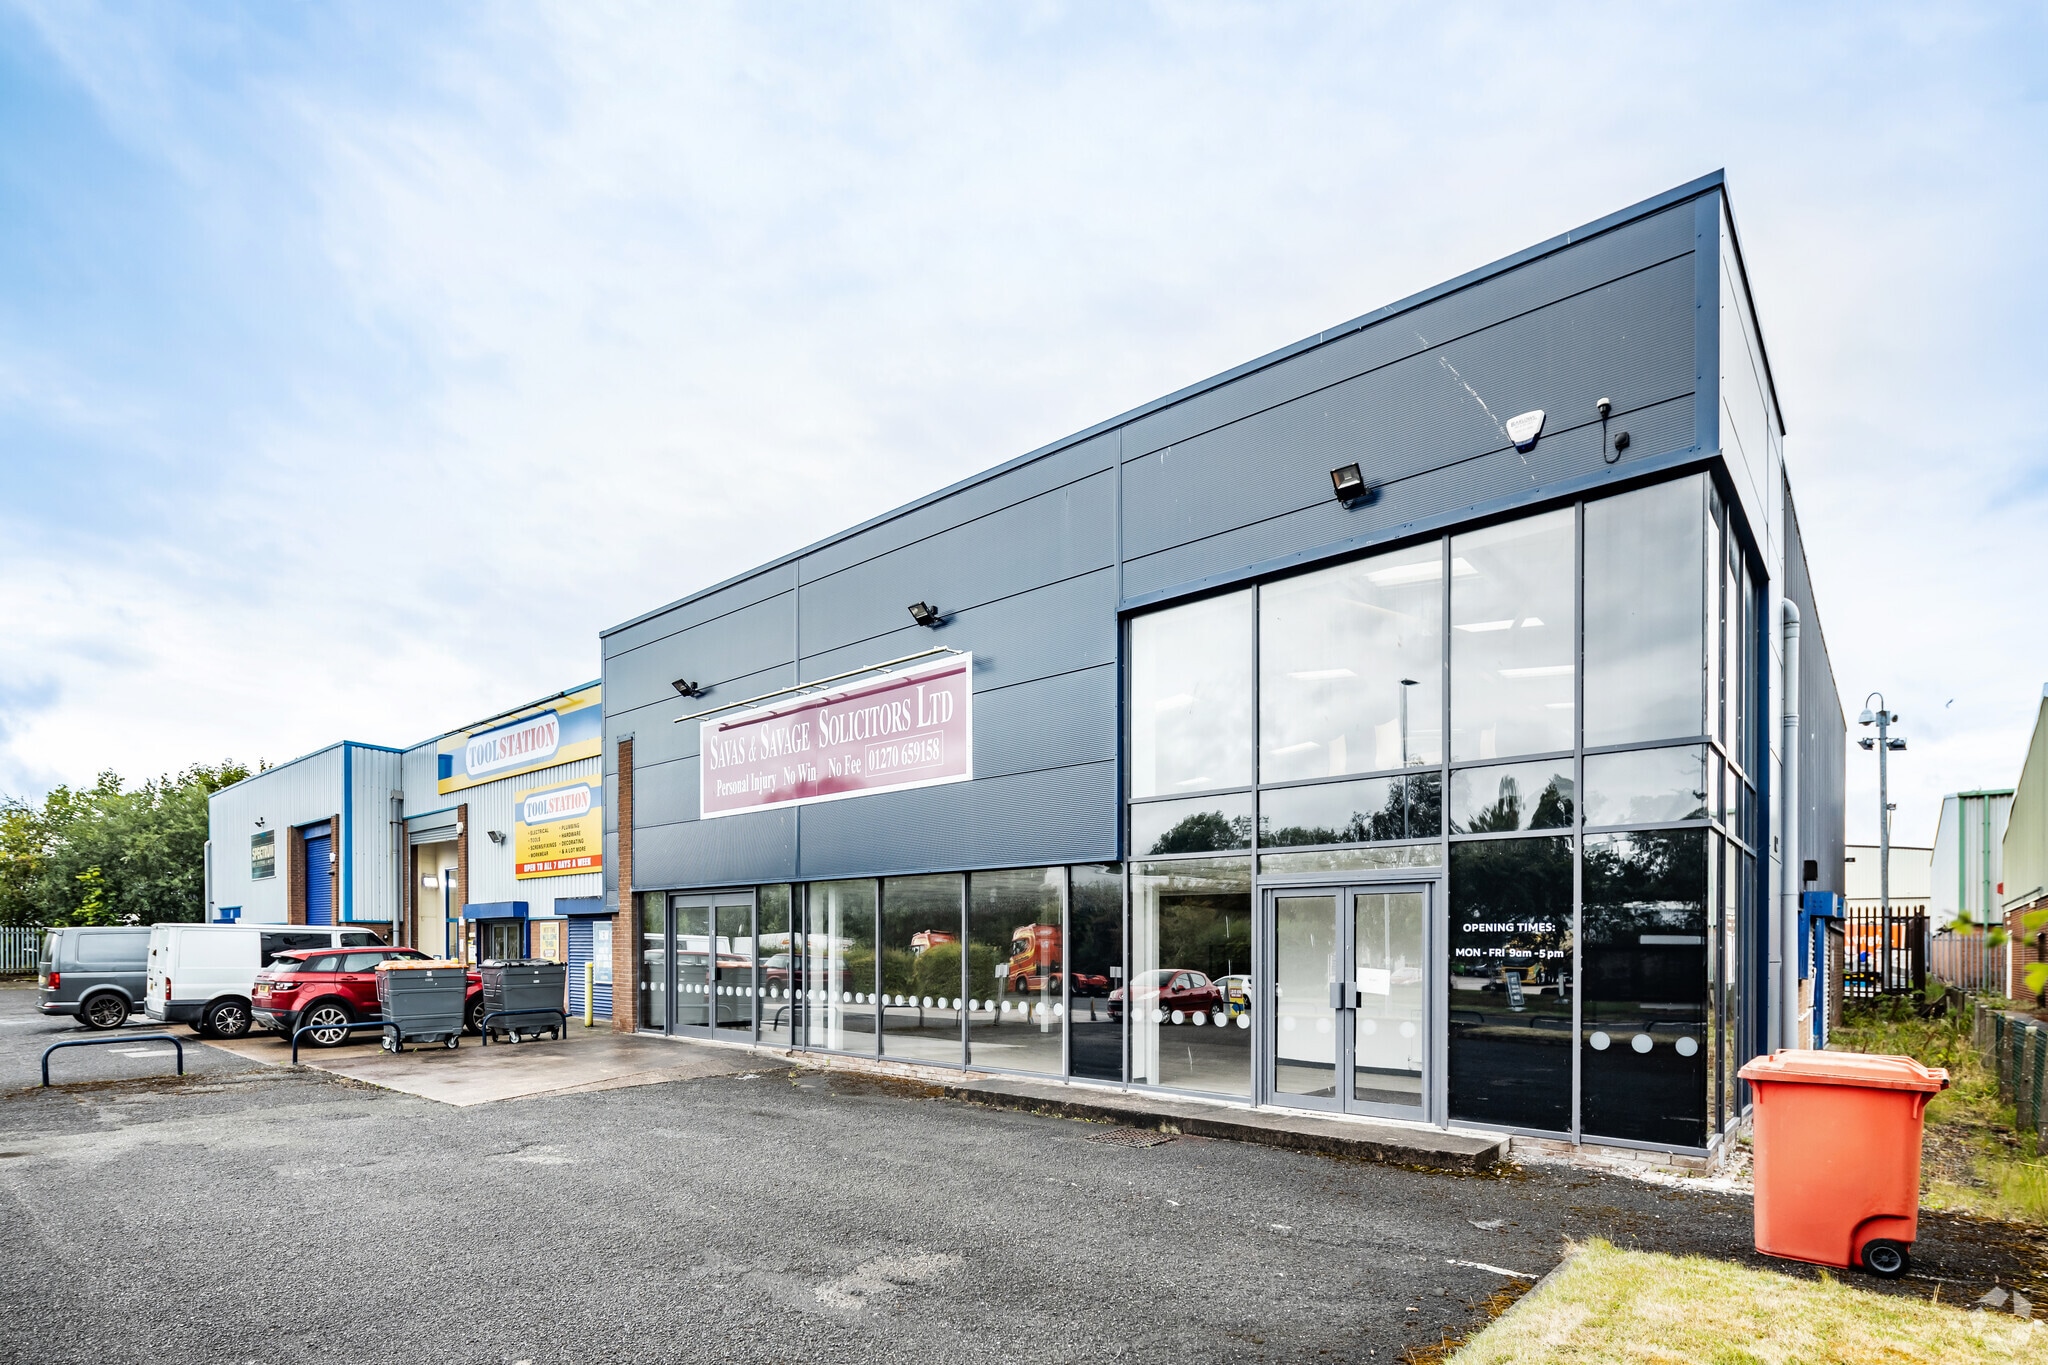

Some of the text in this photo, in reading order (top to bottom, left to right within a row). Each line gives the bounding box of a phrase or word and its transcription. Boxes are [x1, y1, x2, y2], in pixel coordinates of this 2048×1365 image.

[469, 722, 556, 768] TOOLSTATION
[711, 684, 954, 770] SAVAS & SAVAGE SOLICITORS LTD
[716, 737, 940, 796] Personal Injury No Win No Fee 01270 659158
[526, 790, 589, 818] TOOLSTATION
[1462, 922, 1556, 932] OPENING TIMES:
[1455, 948, 1481, 957] MON
[1488, 948, 1505, 957] FRI
[1509, 948, 1532, 957] 9am
